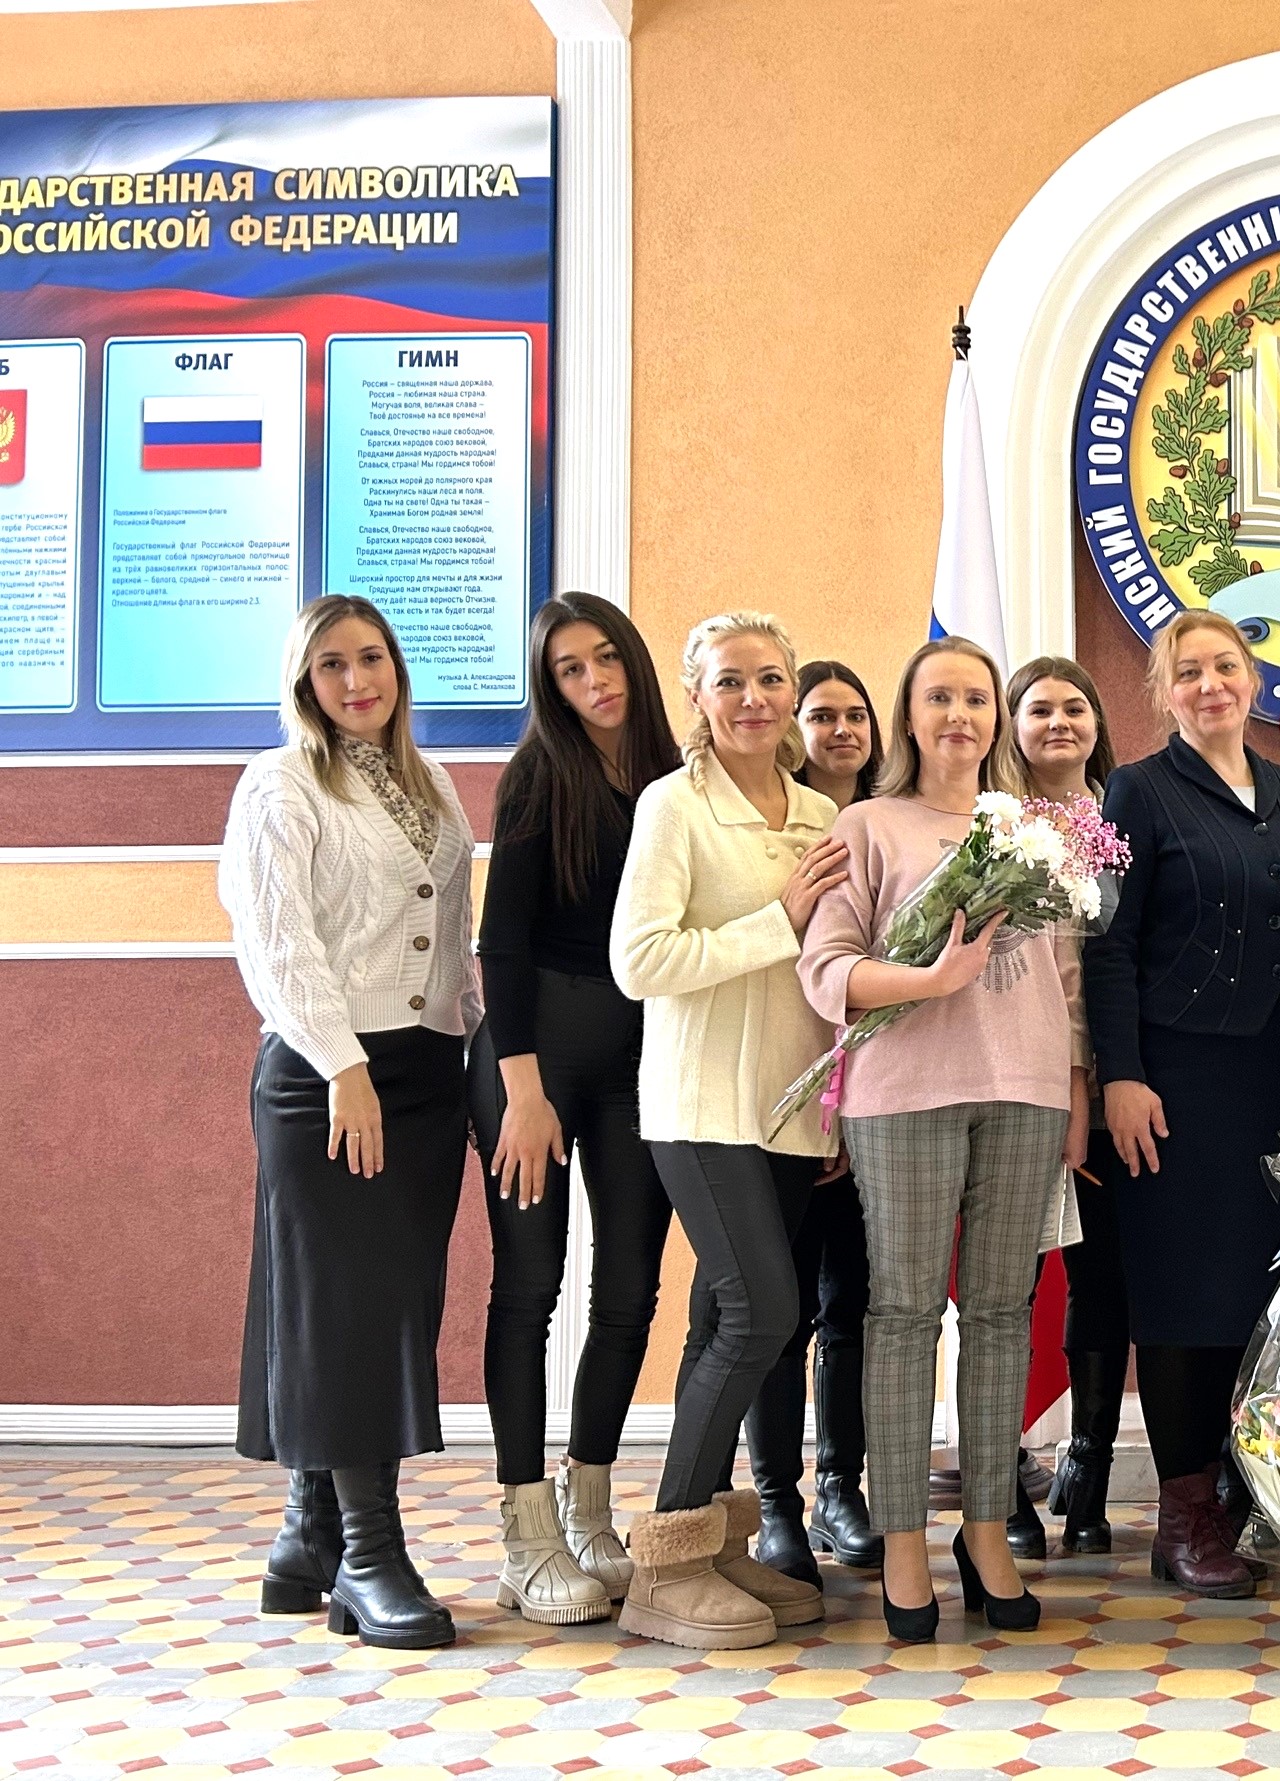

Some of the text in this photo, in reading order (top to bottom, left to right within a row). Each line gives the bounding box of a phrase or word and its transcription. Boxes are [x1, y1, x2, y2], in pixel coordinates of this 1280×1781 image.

[274, 165, 520, 200] СИМВОЛИКА
[229, 212, 458, 252] ФЕДЕРАЦИИ
[174, 353, 233, 371] ФЛАГ
[397, 350, 459, 368] ГИМН
[372, 401, 402, 410] Могучая
[453, 411, 486, 420] времена!
[368, 439, 401, 448] Братских
[358, 450, 394, 459] Предками
[460, 449, 496, 458] народная!
[392, 460, 419, 469] страна!
[400, 476, 423, 485] морей
[369, 487, 416, 496] Раскинулись
[364, 498, 382, 506] Одна
[430, 497, 449, 506] Одна
[370, 509, 405, 518] Хранимая
[1085, 504, 1182, 630] НСКИЙ
[349, 574, 383, 583] Широкий
[369, 585, 404, 594] Грядущие
[390, 596, 406, 604] даёт
[445, 606, 465, 615] будет
[468, 606, 494, 614] всегда!
[458, 644, 495, 653] народная!
